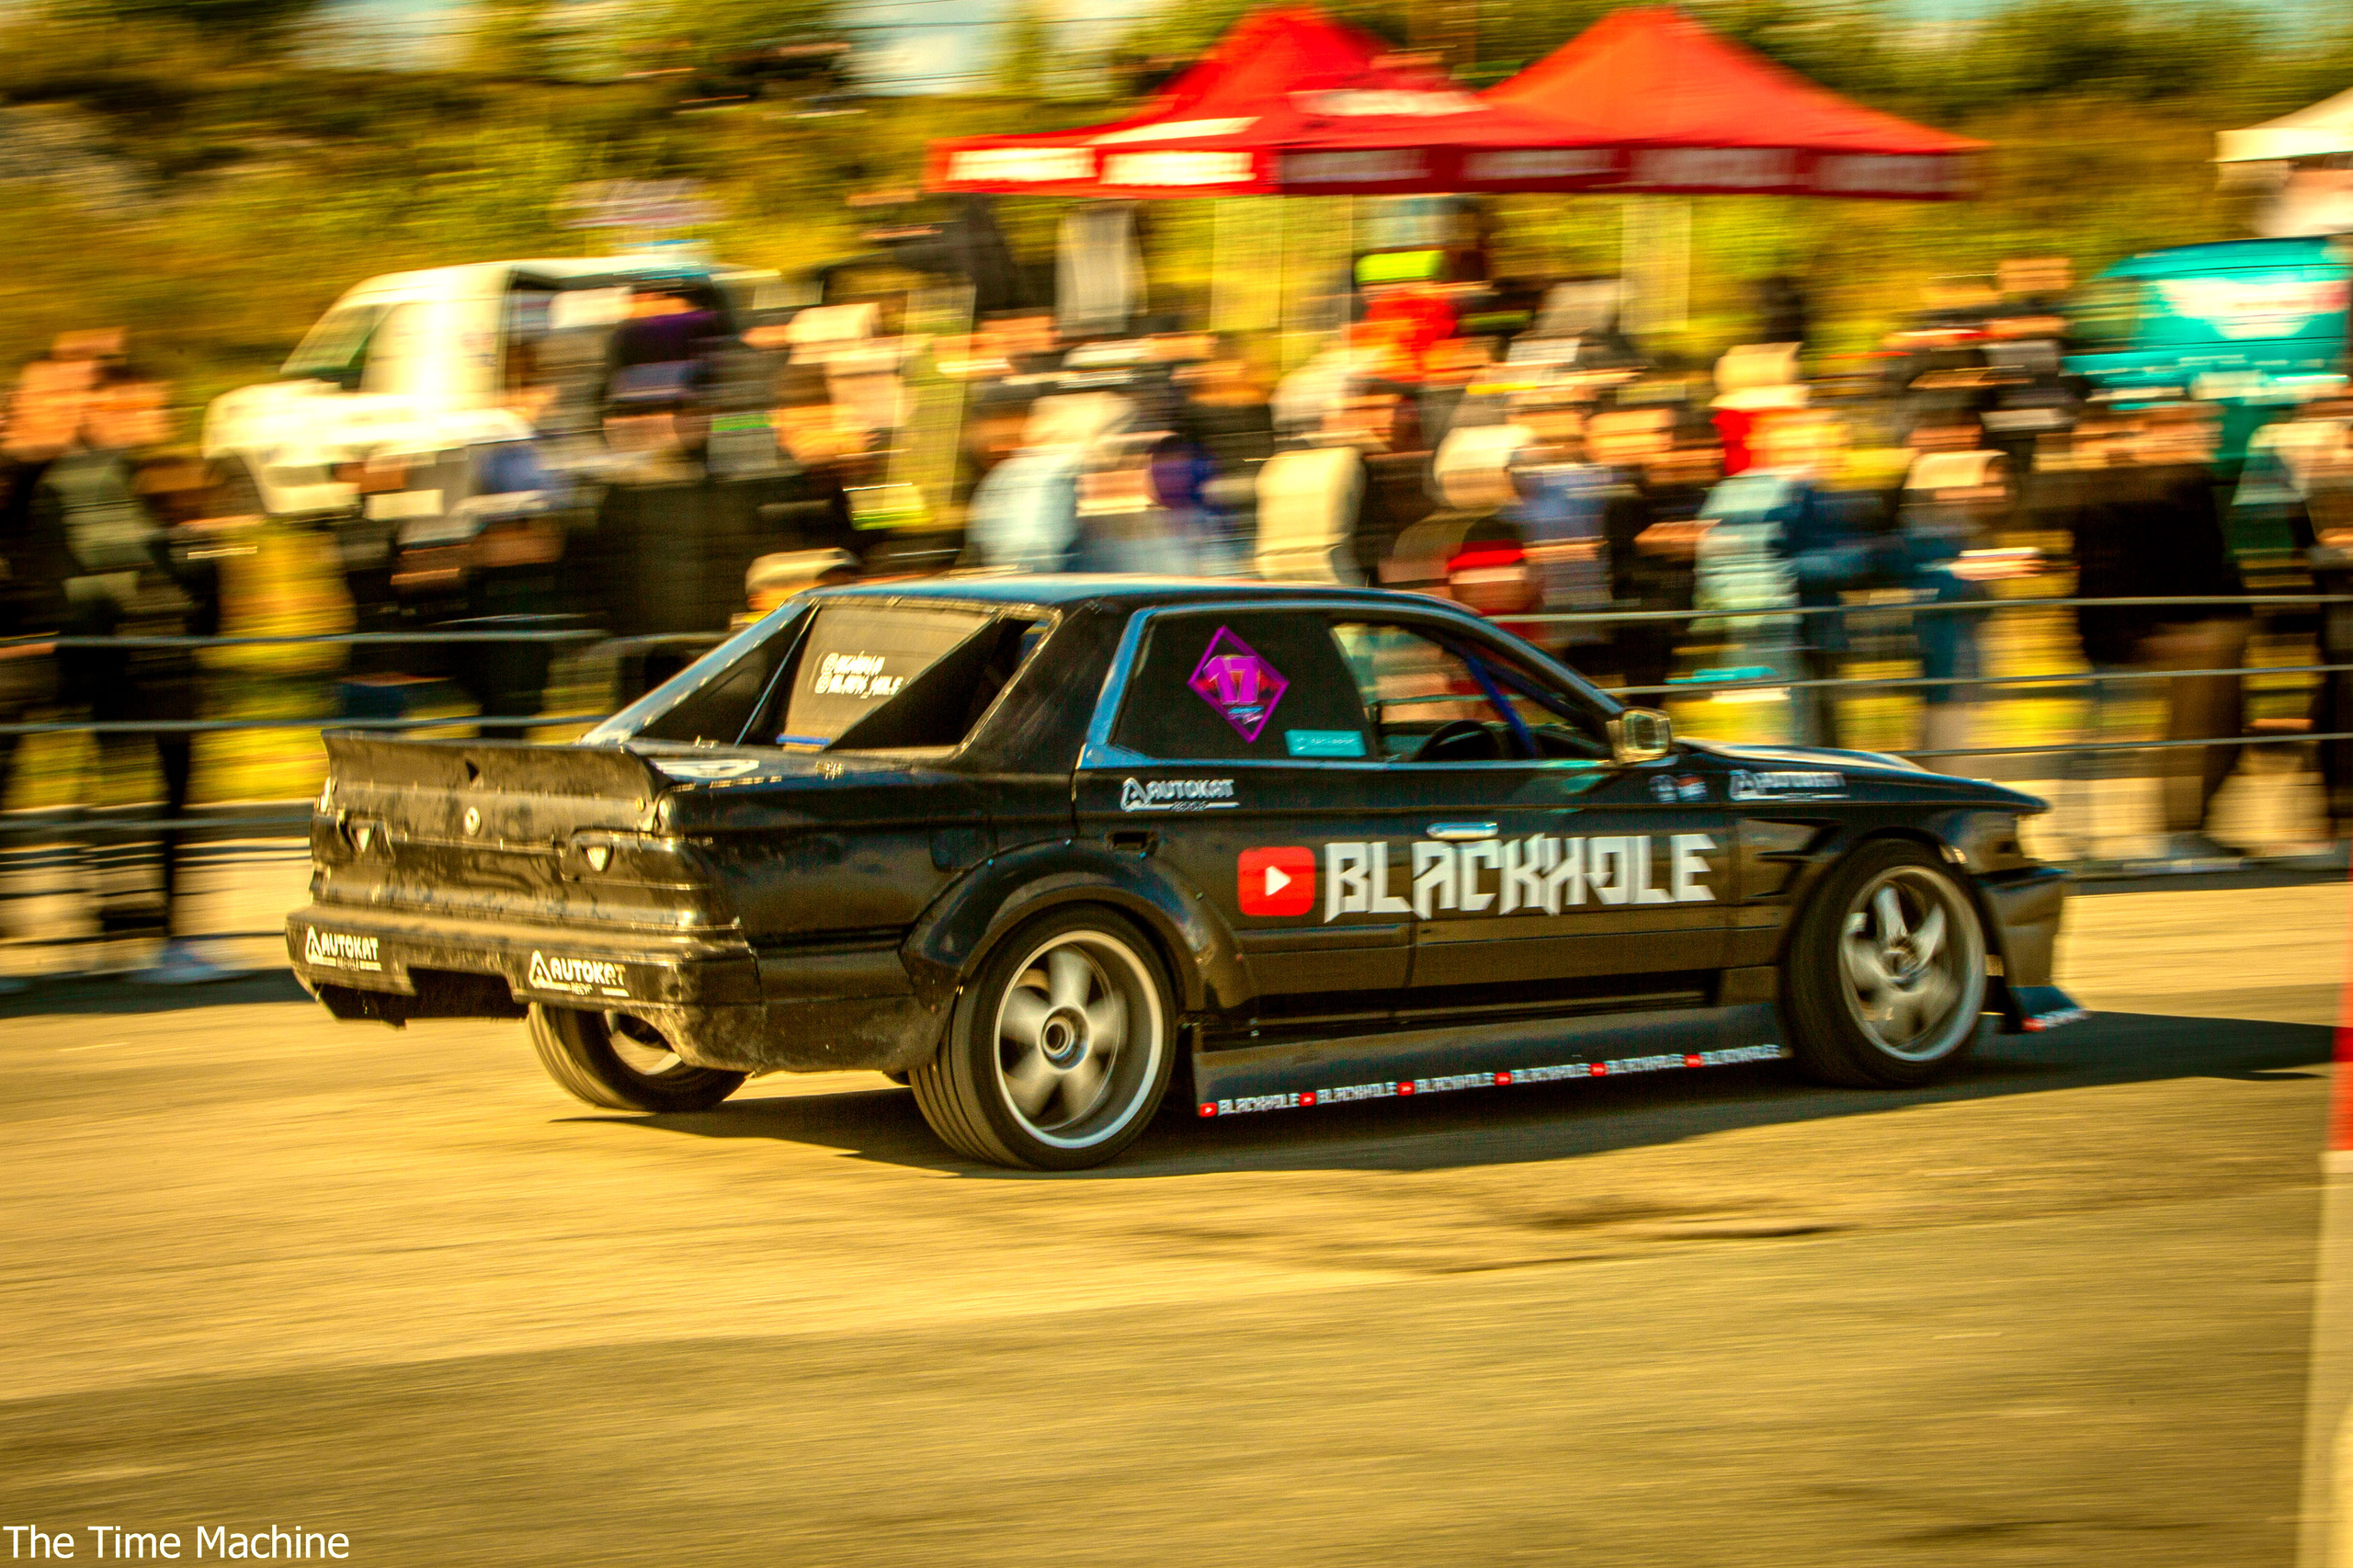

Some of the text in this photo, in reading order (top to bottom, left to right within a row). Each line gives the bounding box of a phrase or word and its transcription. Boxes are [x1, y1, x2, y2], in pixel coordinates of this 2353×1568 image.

[1146, 779, 1234, 800] AUTOKAT
[1324, 834, 1717, 924] BLACKHOLE
[321, 932, 379, 960] AUTOKAT
[550, 957, 626, 986] AUTOKAT
[1218, 1093, 1300, 1116] BLACKHOLE
